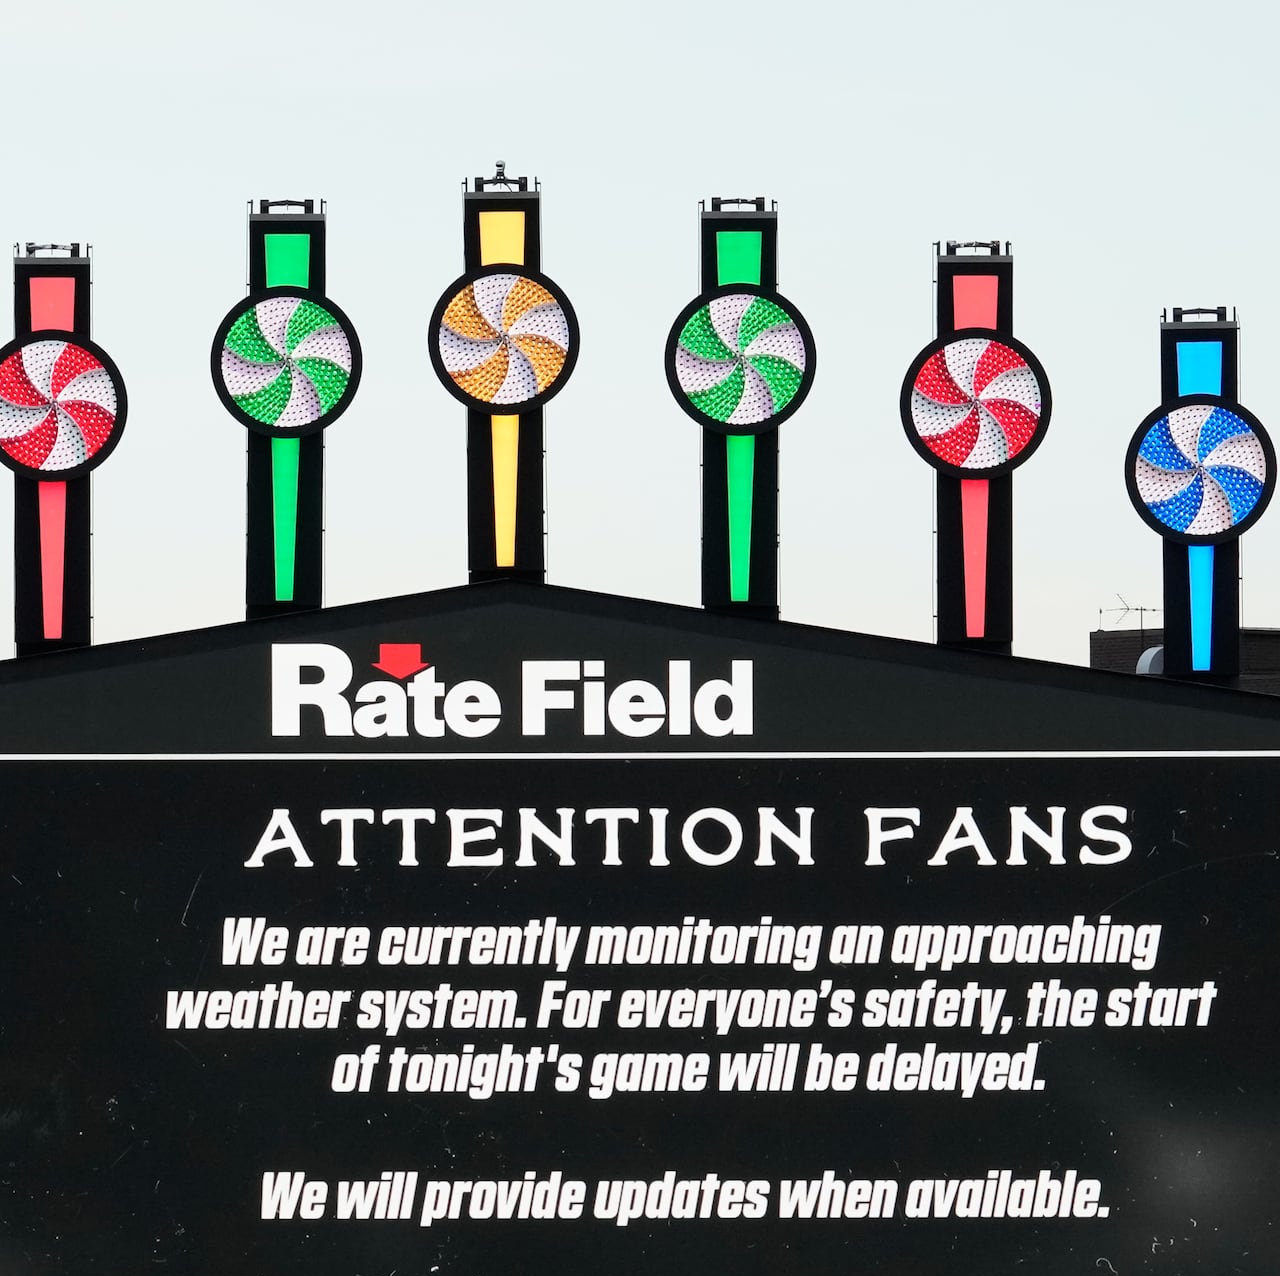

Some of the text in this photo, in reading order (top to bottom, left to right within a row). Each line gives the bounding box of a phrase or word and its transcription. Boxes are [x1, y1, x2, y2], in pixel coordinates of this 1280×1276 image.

[272, 644, 754, 738] Rate Field
[244, 806, 1133, 867] ATTENTION FANS
[222, 915, 1162, 972] We are currently monitoring an approaching
[166, 981, 352, 1029] weather
[357, 984, 527, 1036] system.
[537, 980, 612, 1028] For
[862, 979, 1014, 1034] safety,
[1026, 979, 1098, 1027] the
[1105, 980, 1218, 1027] start
[332, 1043, 1046, 1100] of tonight's game will be delayed.
[261, 1170, 1110, 1227] We will provide updates when available.
